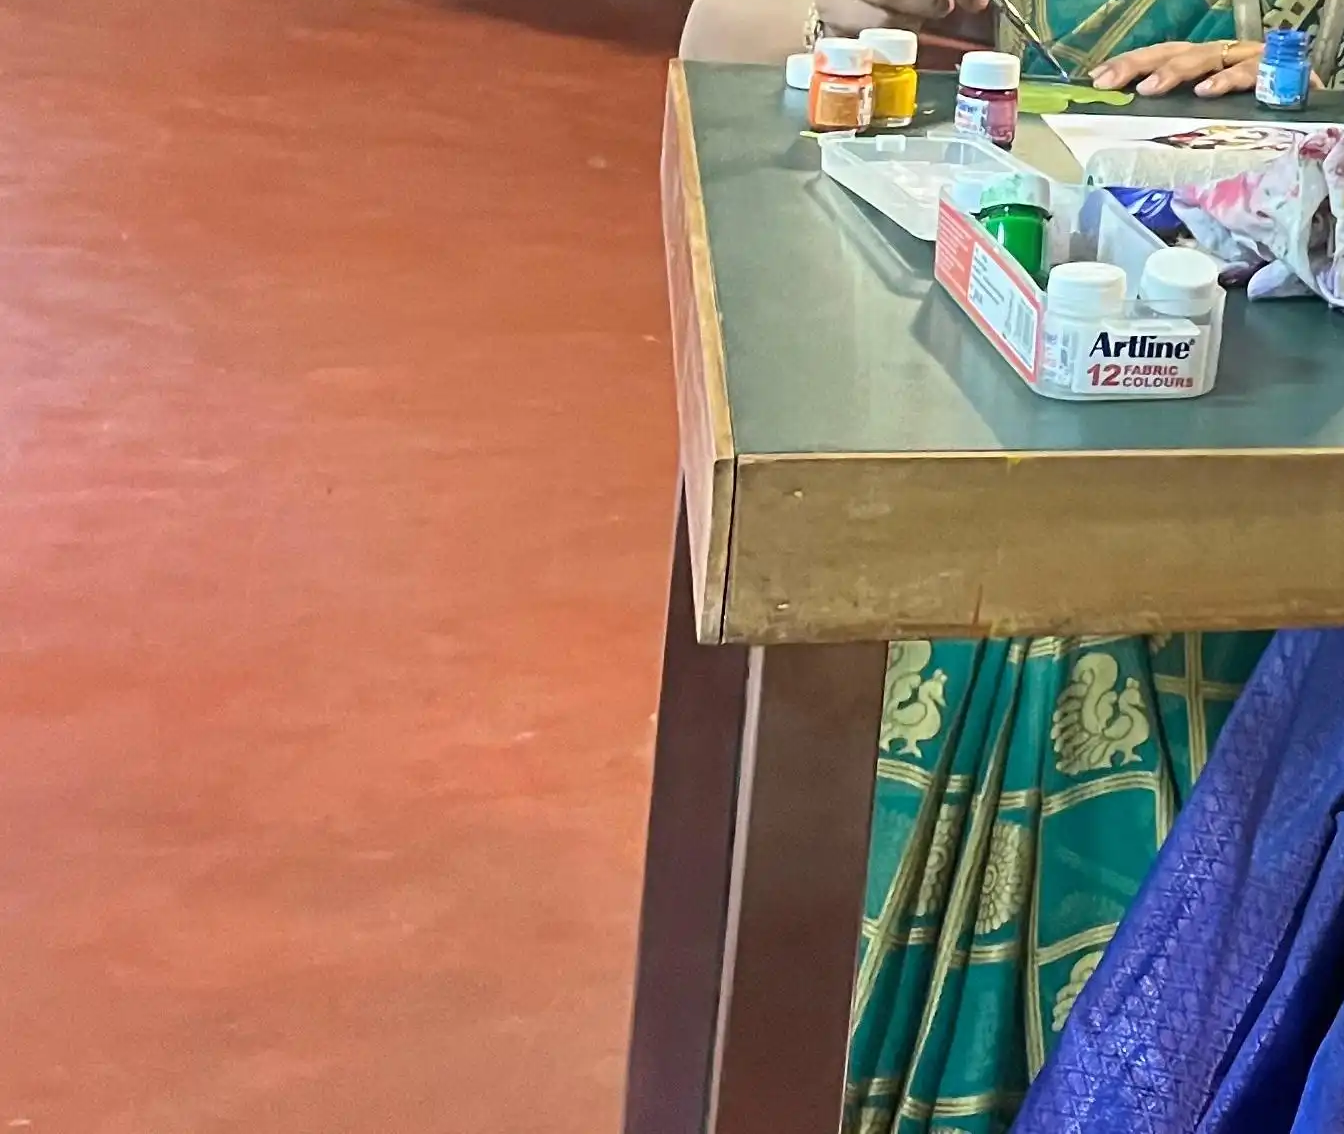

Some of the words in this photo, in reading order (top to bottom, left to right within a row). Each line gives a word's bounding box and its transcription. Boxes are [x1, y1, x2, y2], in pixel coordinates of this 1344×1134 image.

[1089, 331, 1190, 359] Artline
[1087, 363, 1121, 386] 12
[1123, 365, 1179, 376] FABRIC
[1122, 377, 1194, 388] COLOURS
